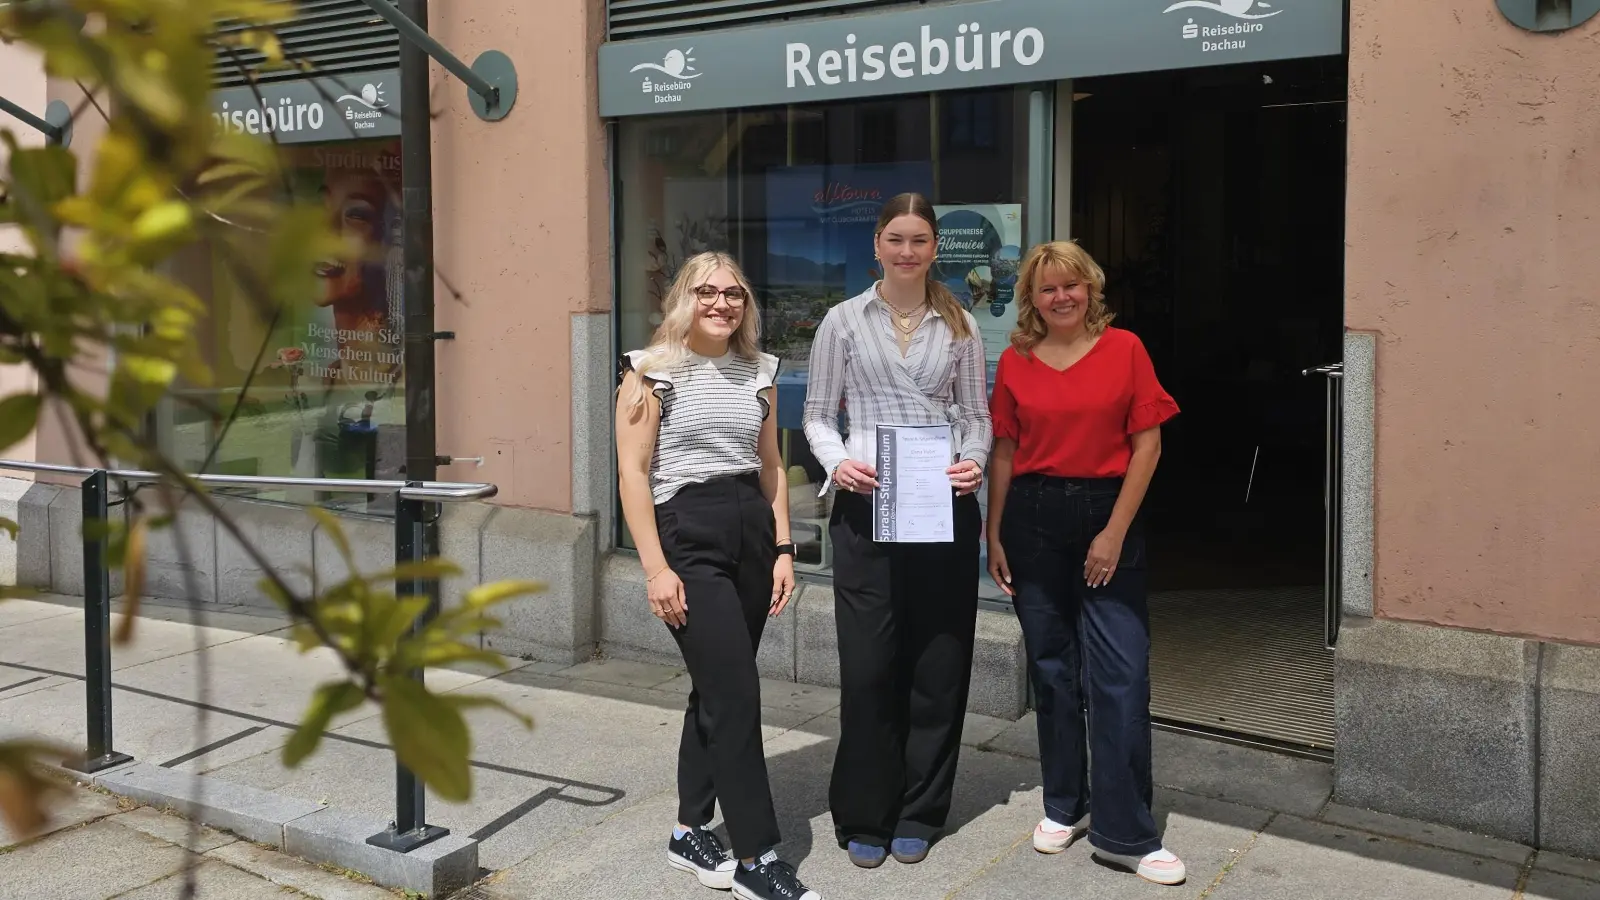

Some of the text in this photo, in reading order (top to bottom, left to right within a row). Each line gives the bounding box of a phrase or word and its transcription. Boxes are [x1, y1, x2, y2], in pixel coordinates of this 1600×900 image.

[1202, 22, 1263, 37] Reisebüro
[1202, 39, 1246, 51] Dachau
[786, 21, 1045, 88] Reisebüro
[654, 81, 691, 92] Reisebüro
[654, 94, 681, 103] Dachau
[212, 97, 324, 135] eisebüro
[354, 110, 381, 119] Reisebüro
[354, 120, 375, 129] Dachau
[937, 236, 985, 251] Albanien
[308, 322, 401, 344] Begegnen Sie
[301, 341, 405, 364] Menschen und
[310, 362, 396, 384] ihrer Kultur
[880, 434, 892, 541] Sprach-Stipendium
